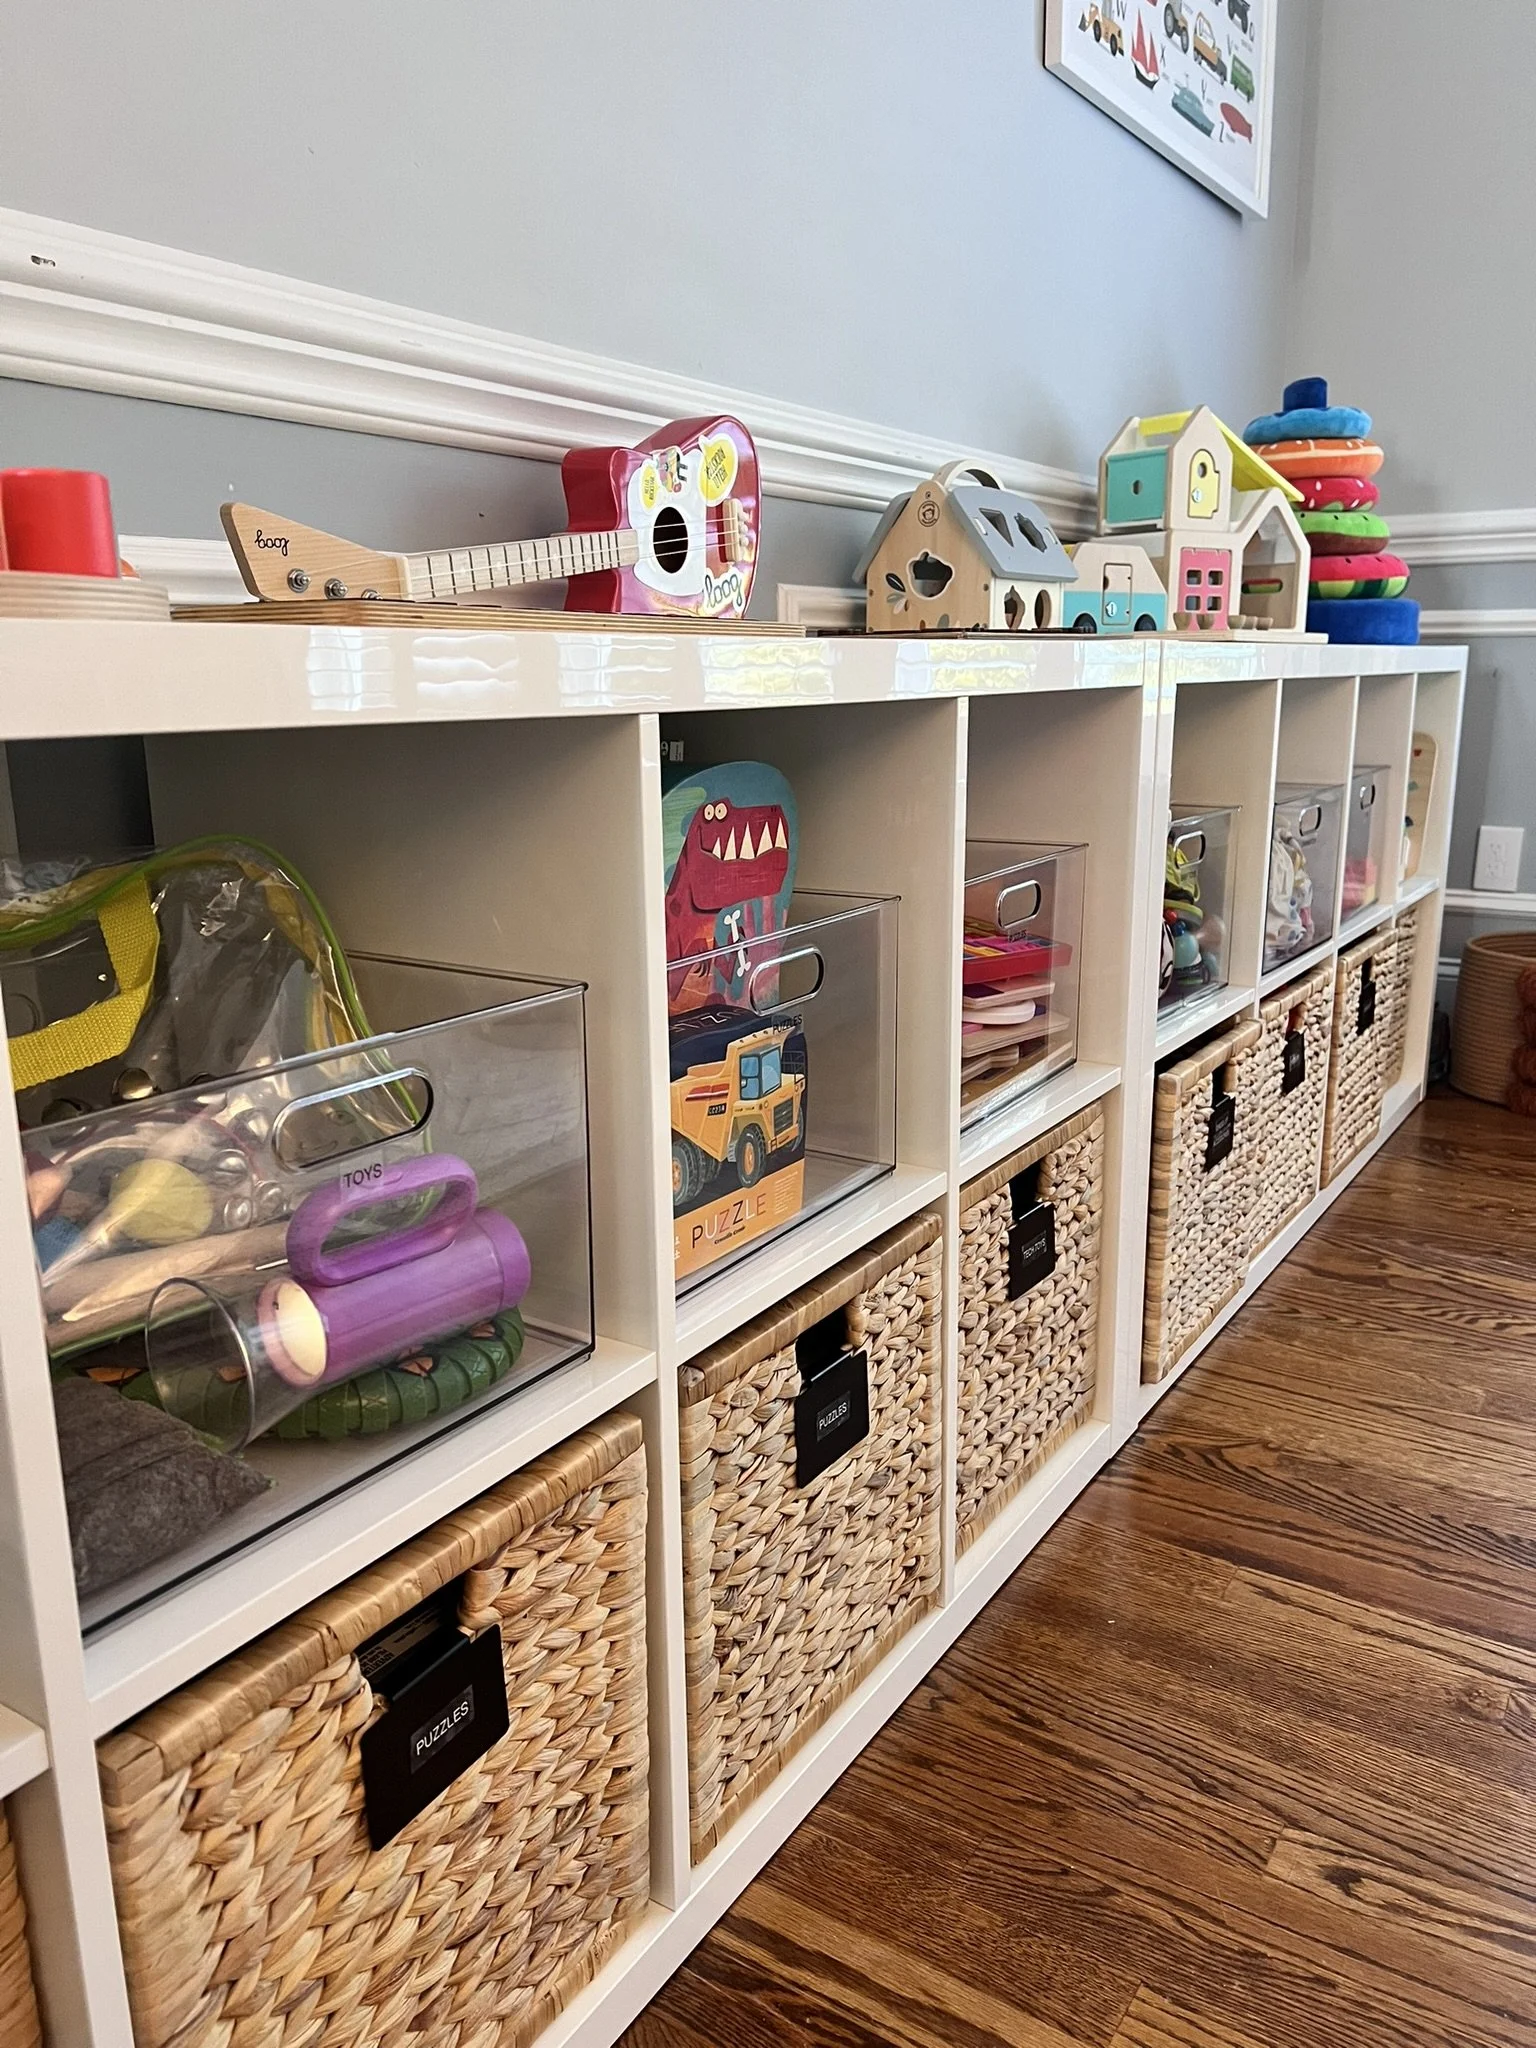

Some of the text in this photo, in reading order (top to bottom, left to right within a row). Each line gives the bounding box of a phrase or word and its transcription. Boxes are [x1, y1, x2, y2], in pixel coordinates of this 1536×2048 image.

[704, 574, 743, 608] loog
[772, 1014, 803, 1035] PUZZLES
[343, 1163, 383, 1188] TOYS
[691, 1193, 768, 1249] PUZZLE
[818, 1401, 848, 1431] PUZZLES
[416, 1700, 470, 1756] PUZZLES
